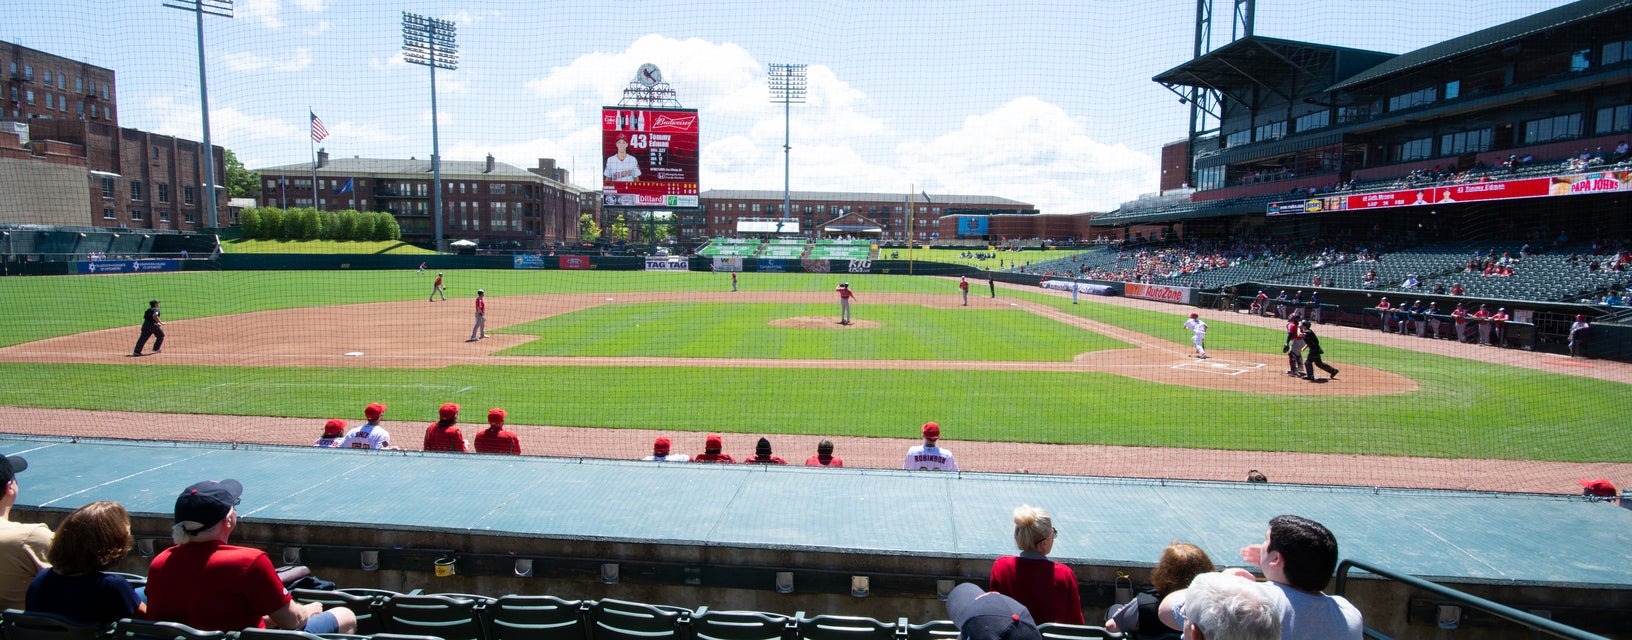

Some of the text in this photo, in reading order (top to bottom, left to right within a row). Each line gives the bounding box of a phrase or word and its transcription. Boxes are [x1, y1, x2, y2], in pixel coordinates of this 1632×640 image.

[624, 87, 676, 97] AUTOZONE
[655, 117, 692, 126] Budweiser
[630, 133, 671, 149] 43 Tommy
[1571, 180, 1591, 192] PAPA
[1146, 285, 1182, 301] AutoZone
[914, 455, 947, 464] ROBINSON
